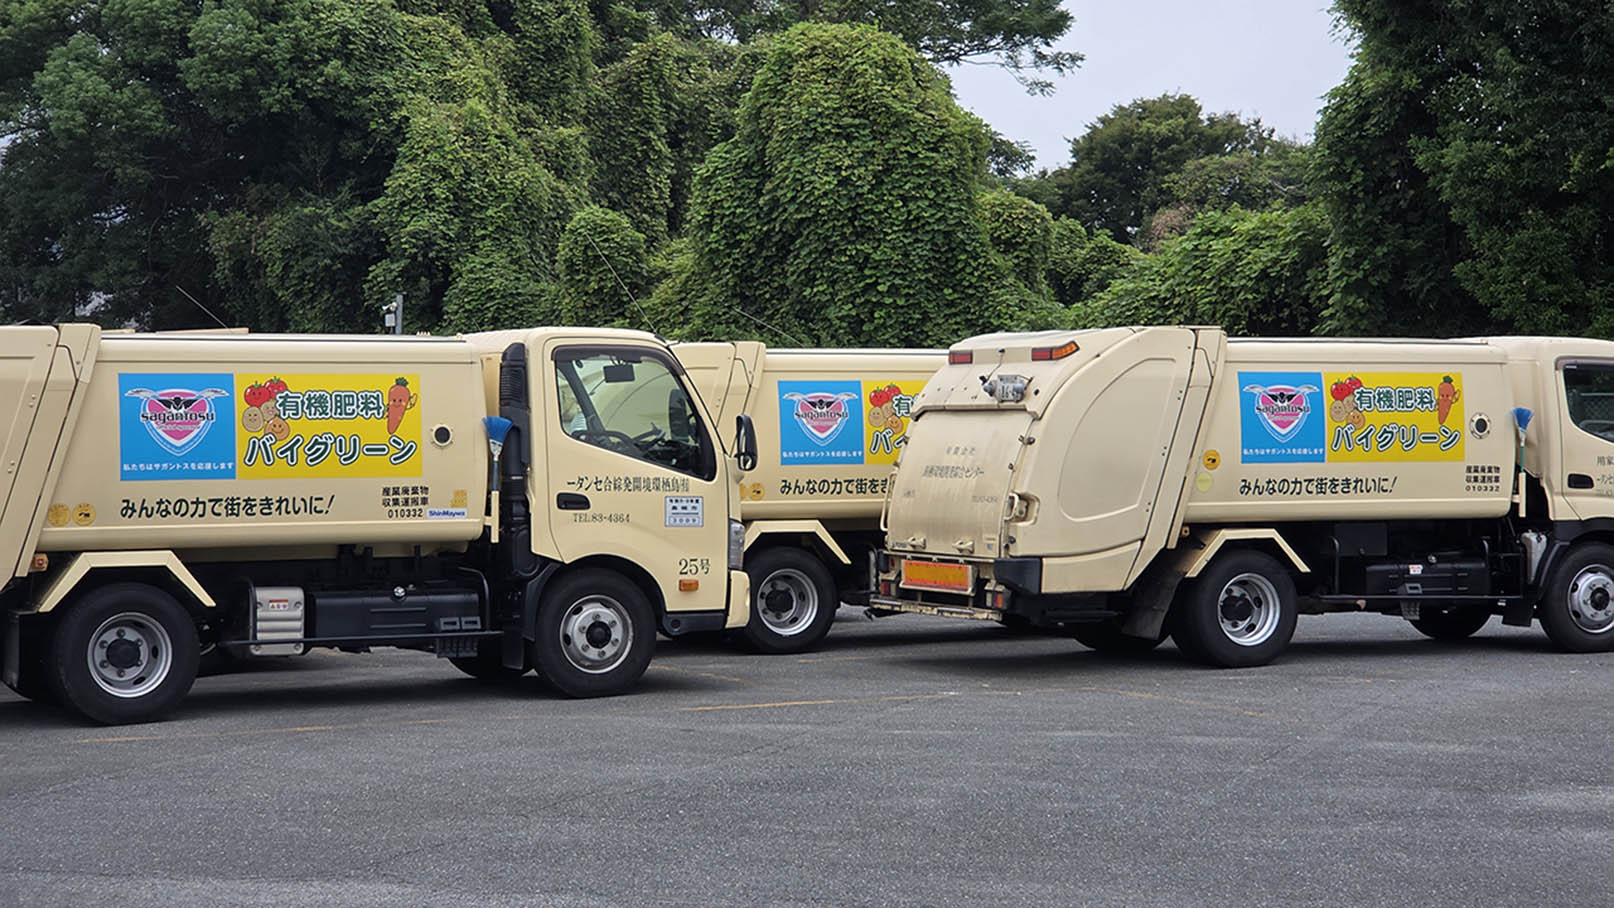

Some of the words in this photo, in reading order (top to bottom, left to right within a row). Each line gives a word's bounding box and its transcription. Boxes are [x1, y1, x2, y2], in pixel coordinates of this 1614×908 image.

[275, 390, 385, 419] 有機肥料
[1355, 386, 1436, 412] 有機肥料
[141, 411, 215, 424] sagantosu
[244, 432, 418, 466] バイグリーン
[1331, 423, 1461, 452] バイグリーン
[388, 509, 423, 518] 010332
[679, 558, 710, 575] 25号
